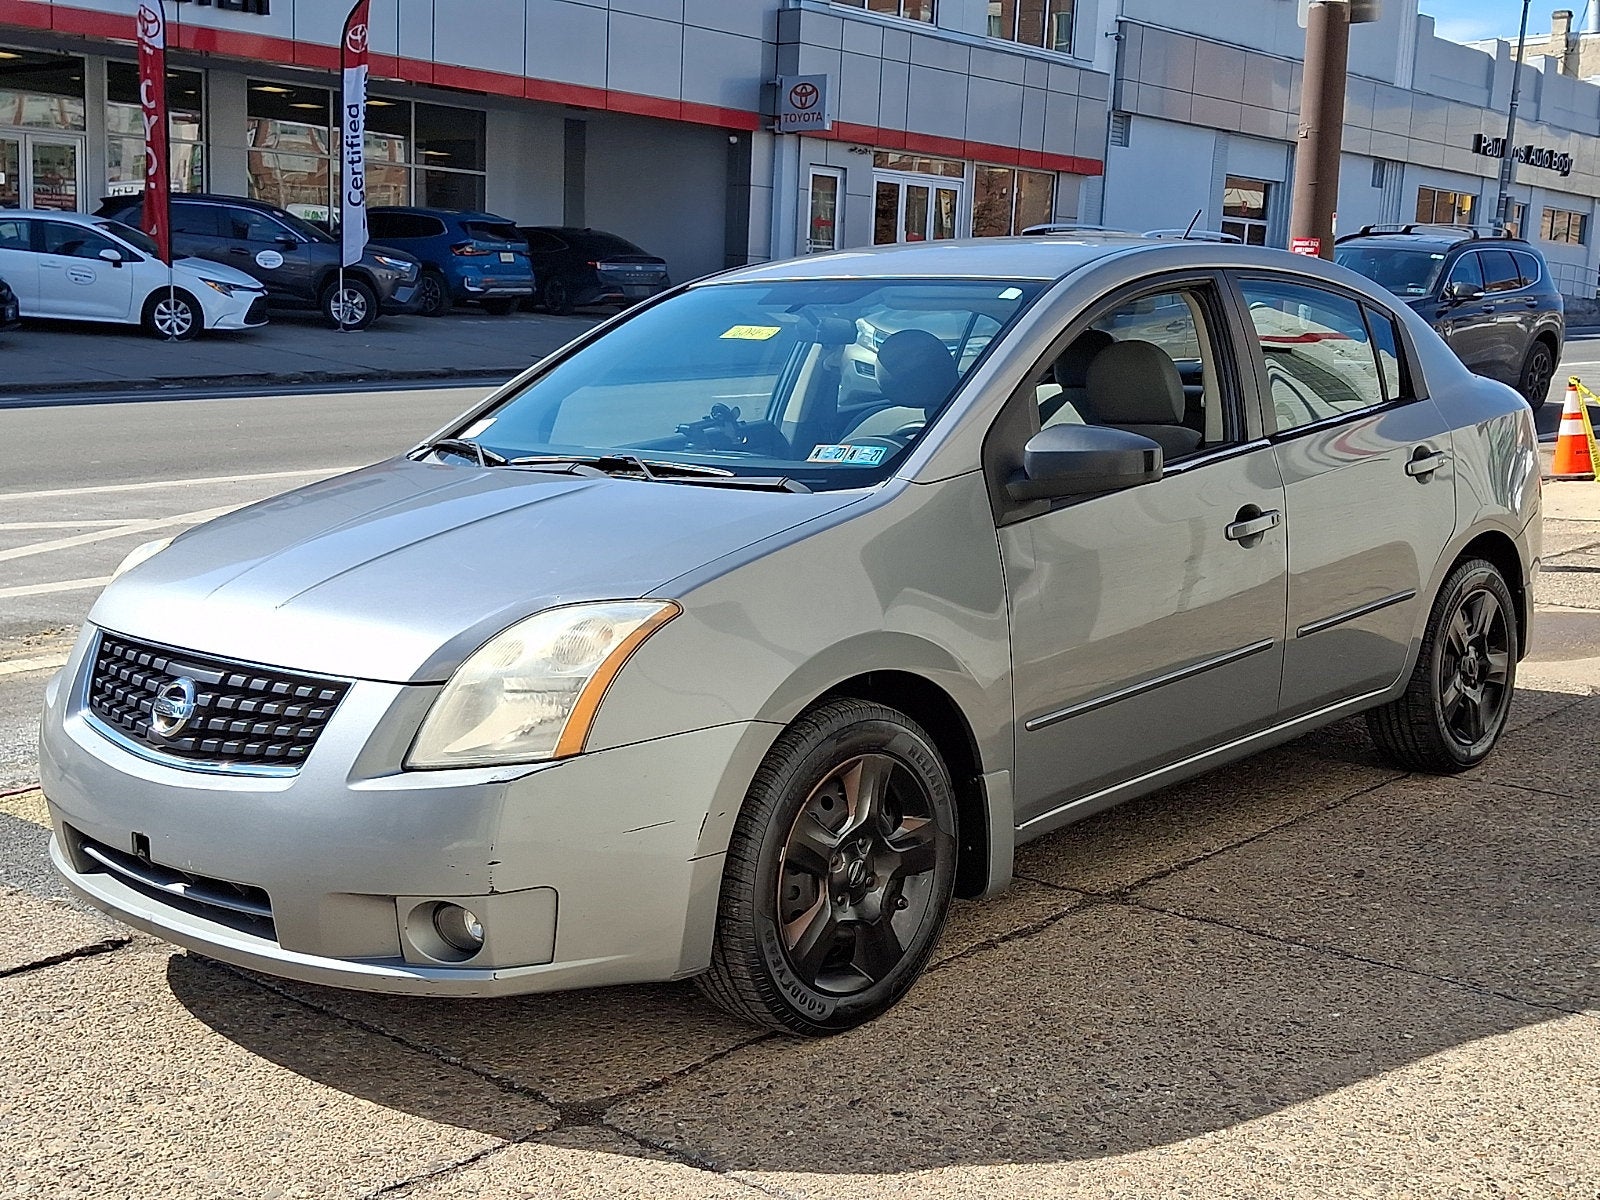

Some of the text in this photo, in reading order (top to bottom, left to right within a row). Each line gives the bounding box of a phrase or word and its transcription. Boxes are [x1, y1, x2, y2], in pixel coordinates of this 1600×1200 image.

[783, 111, 823, 123] TOYOTA
[347, 103, 365, 208] Certified
[1477, 134, 1504, 158] Paul
[1529, 147, 1551, 168] Auto
[1551, 151, 1574, 175] Body
